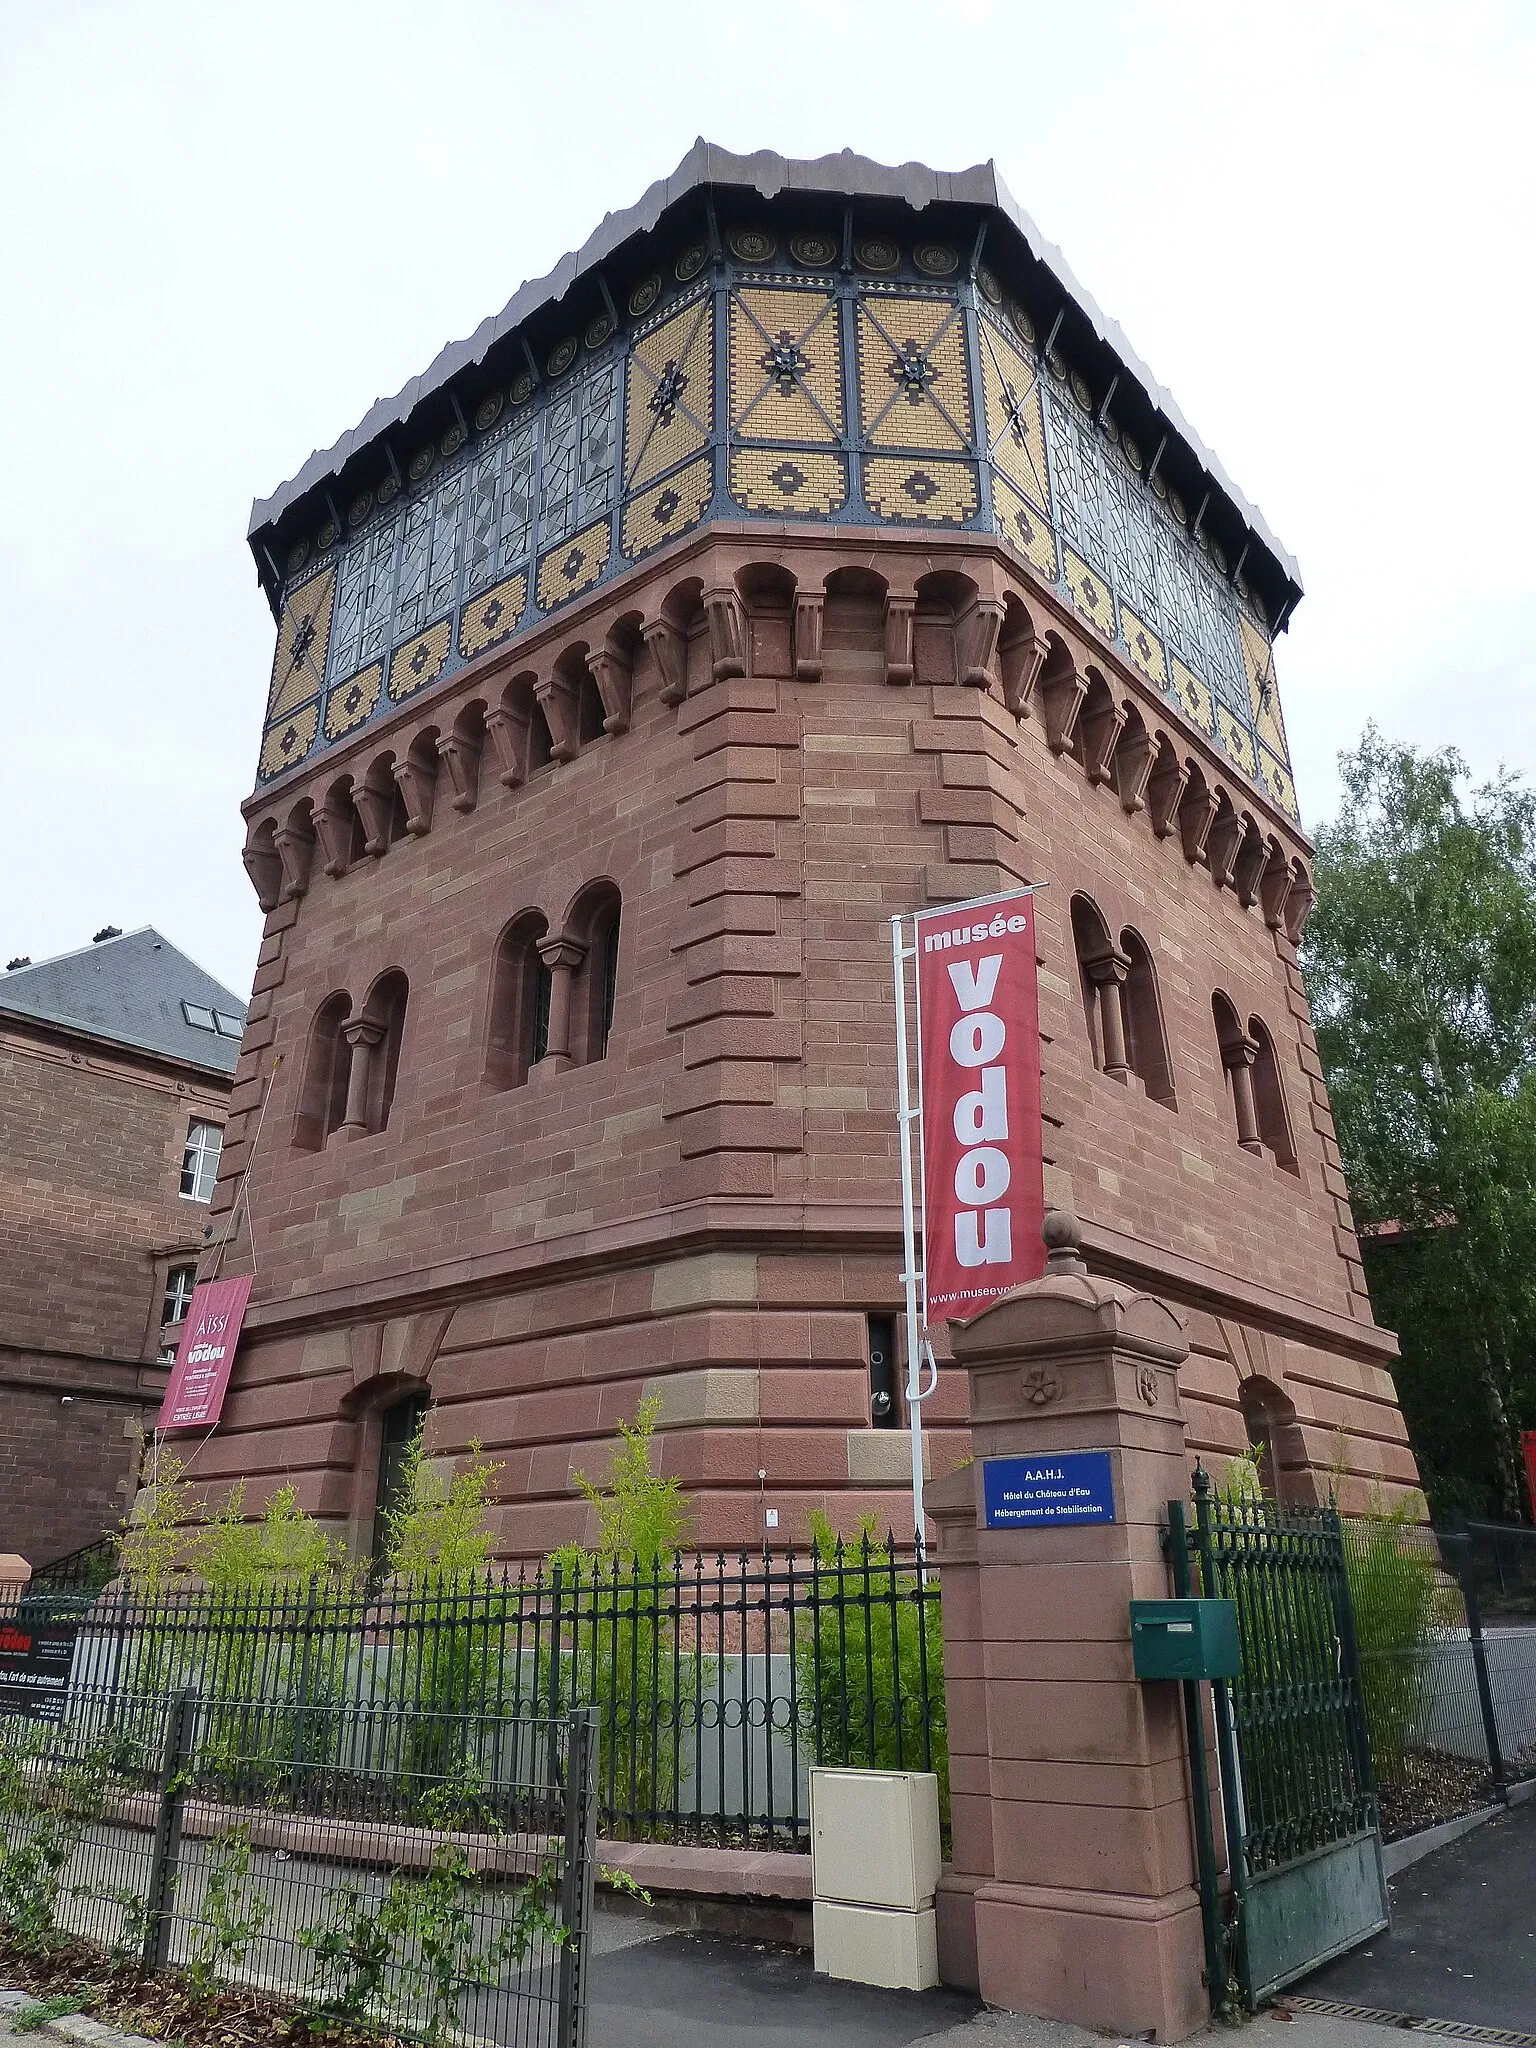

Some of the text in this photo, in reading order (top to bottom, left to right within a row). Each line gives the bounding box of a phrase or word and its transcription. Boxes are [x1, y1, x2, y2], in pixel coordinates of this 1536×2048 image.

[924, 912, 1027, 952] musée
[946, 953, 1014, 1268] vodou
[187, 1344, 226, 1364] vodou
[1025, 1468, 1065, 1481] A.A.H.J.
[1003, 1487, 1091, 1500] Hôtel du Château d'Eau
[994, 1503, 1103, 1518] Hébergement de Stabilisation
